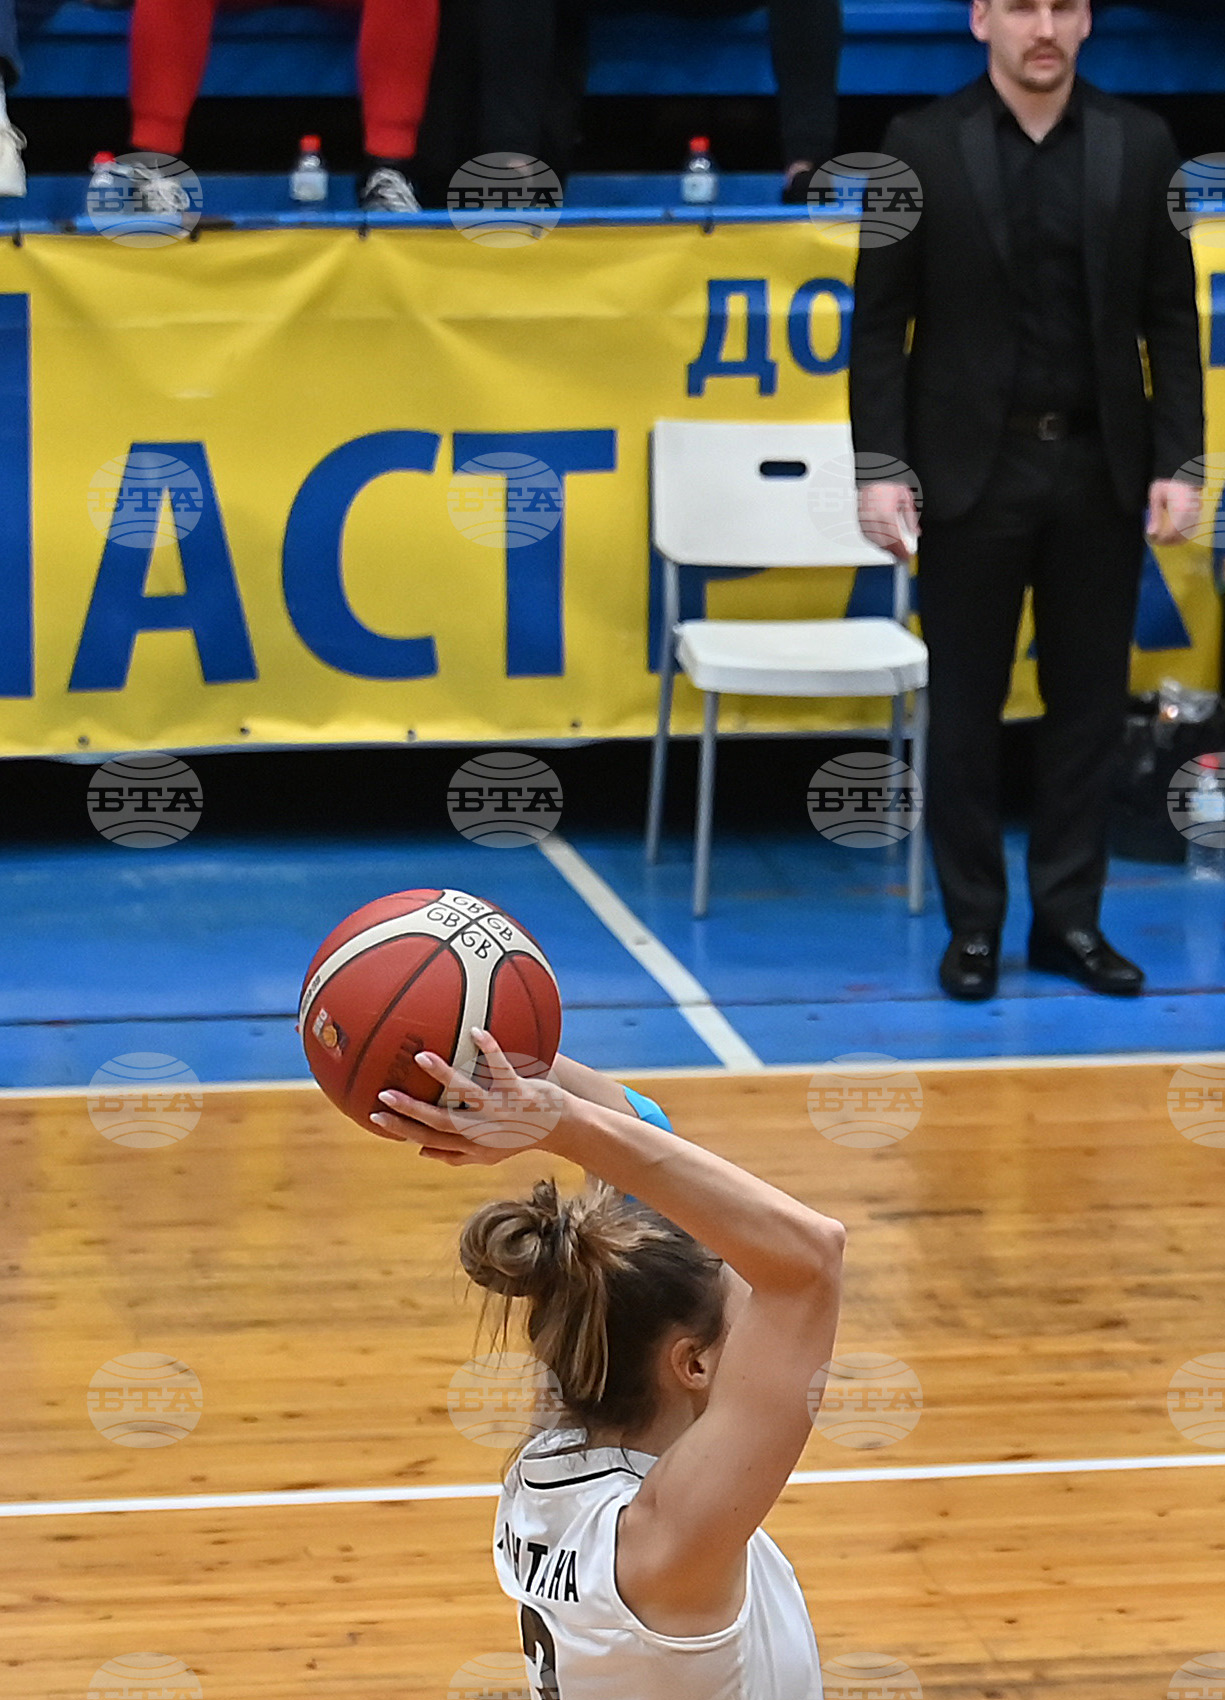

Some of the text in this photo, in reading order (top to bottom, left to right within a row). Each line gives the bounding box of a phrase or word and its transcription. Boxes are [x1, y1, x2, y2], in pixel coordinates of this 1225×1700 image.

[453, 896, 485, 914] GB
[426, 906, 460, 927] GB
[487, 917, 513, 941] GB
[460, 930, 492, 959] GB
